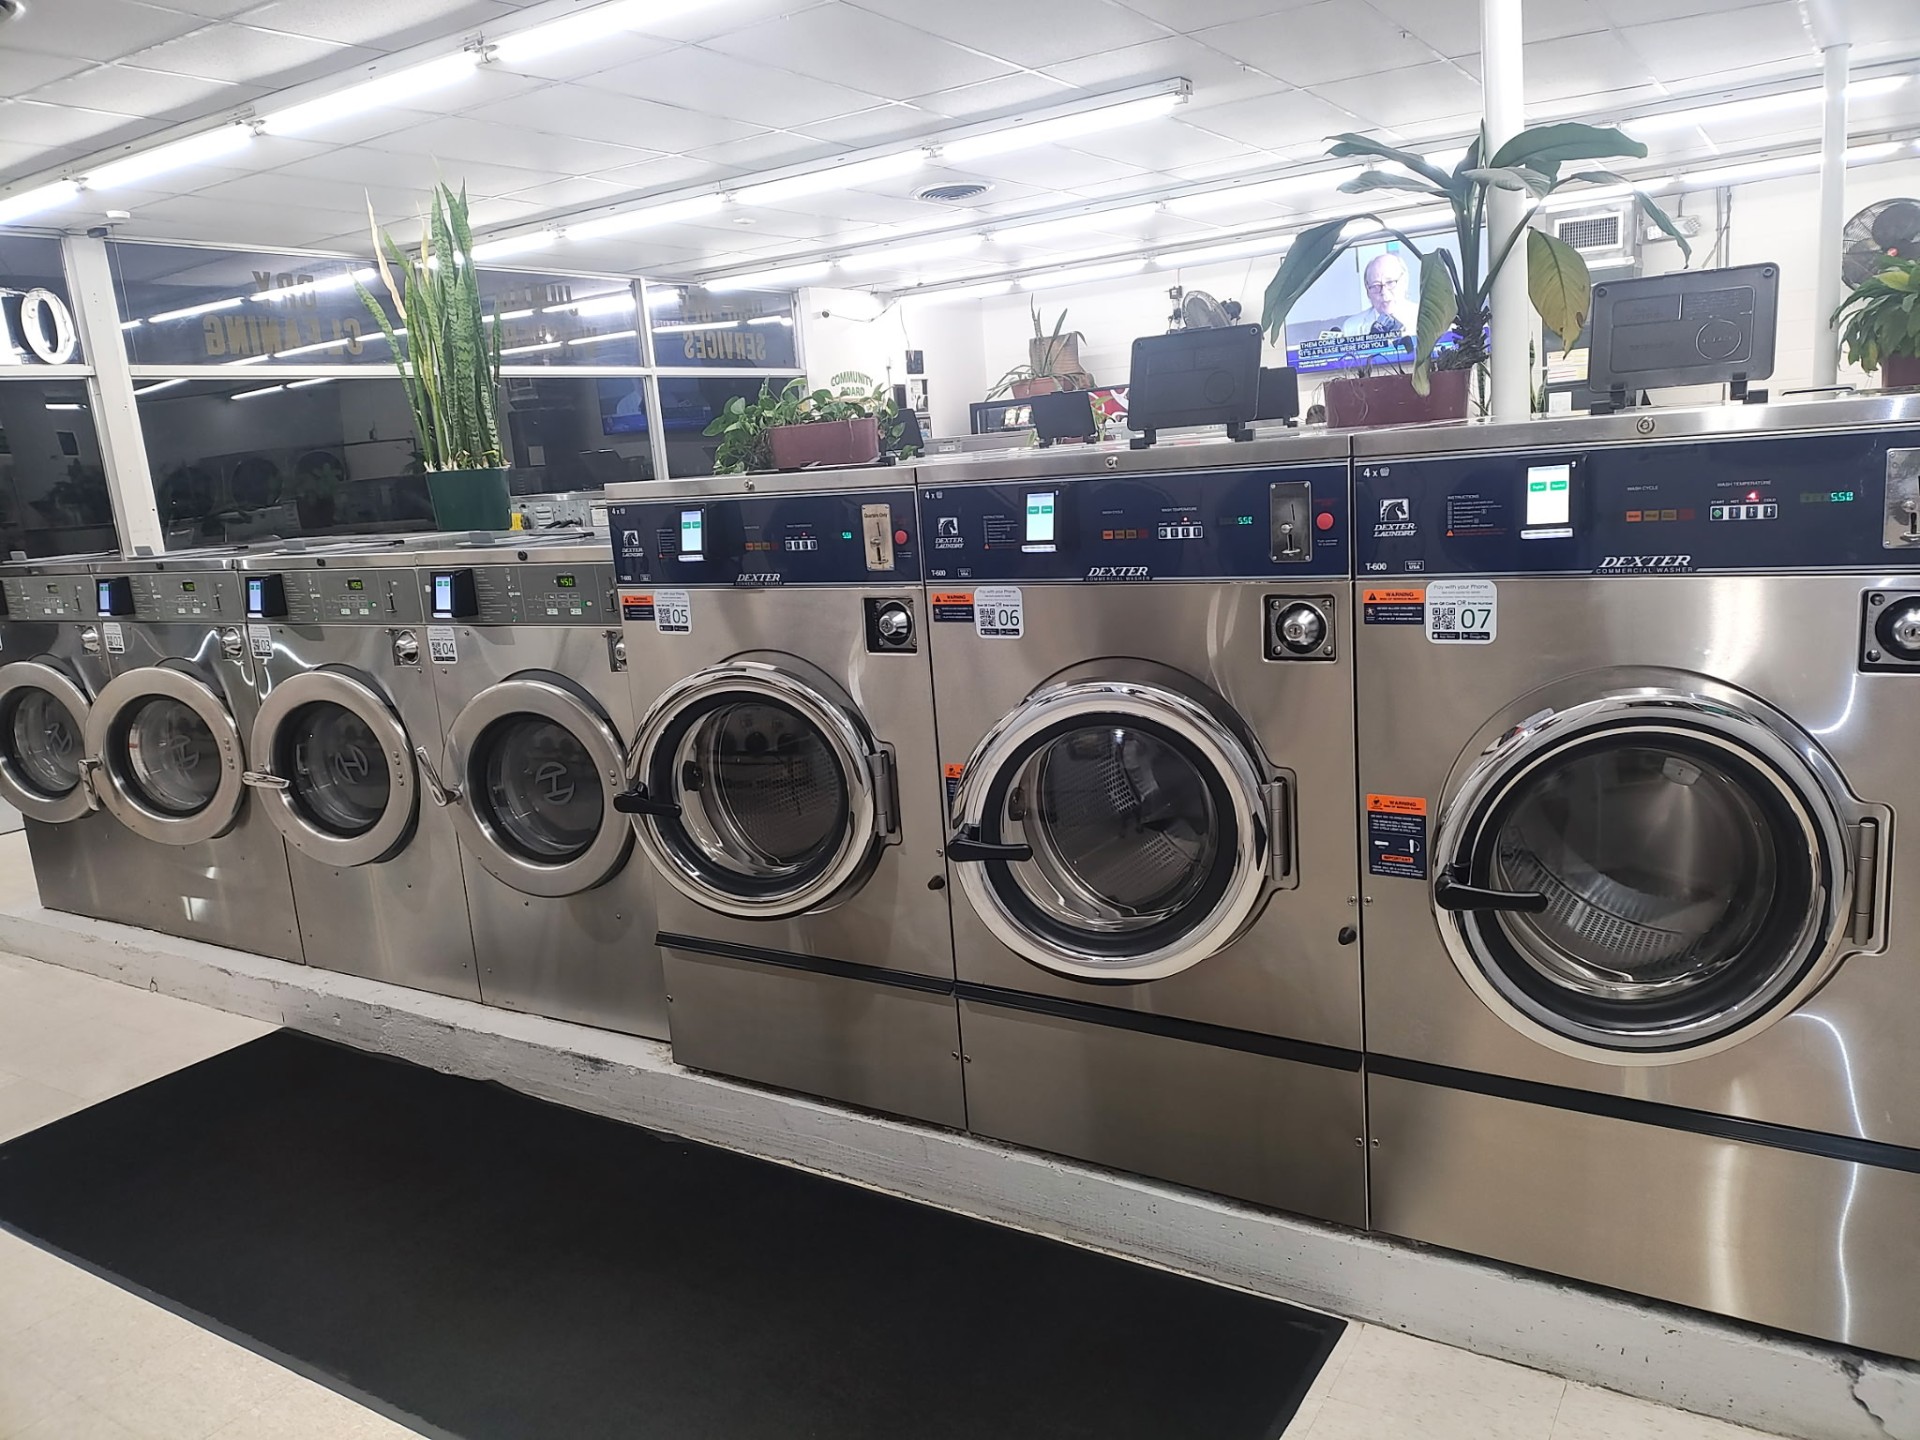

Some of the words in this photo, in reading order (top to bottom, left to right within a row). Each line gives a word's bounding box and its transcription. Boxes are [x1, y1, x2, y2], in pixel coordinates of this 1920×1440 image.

[1301, 341, 1317, 349] THEM
[1318, 338, 1335, 347] COME
[1337, 337, 1345, 345] UP
[1346, 336, 1354, 344] TO
[1340, 344, 1357, 352] WERE
[1358, 342, 1369, 350] FOR
[830, 371, 873, 387] COMMUNITY
[1363, 468, 1370, 477] 4
[925, 491, 930, 499] 4
[611, 507, 616, 515] 4
[1373, 523, 1415, 531] DEXTER
[1365, 562, 1387, 571] T-600
[1599, 555, 1692, 568] DEXTER
[931, 569, 946, 577] T-600
[1087, 566, 1149, 576] DEXTER
[737, 573, 781, 582] DEXTER
[672, 609, 688, 624] 05
[998, 609, 1020, 626] 06
[1461, 609, 1491, 629] 07
[113, 636, 122, 647] 02
[260, 640, 271, 651] 03
[442, 642, 455, 655] 04
